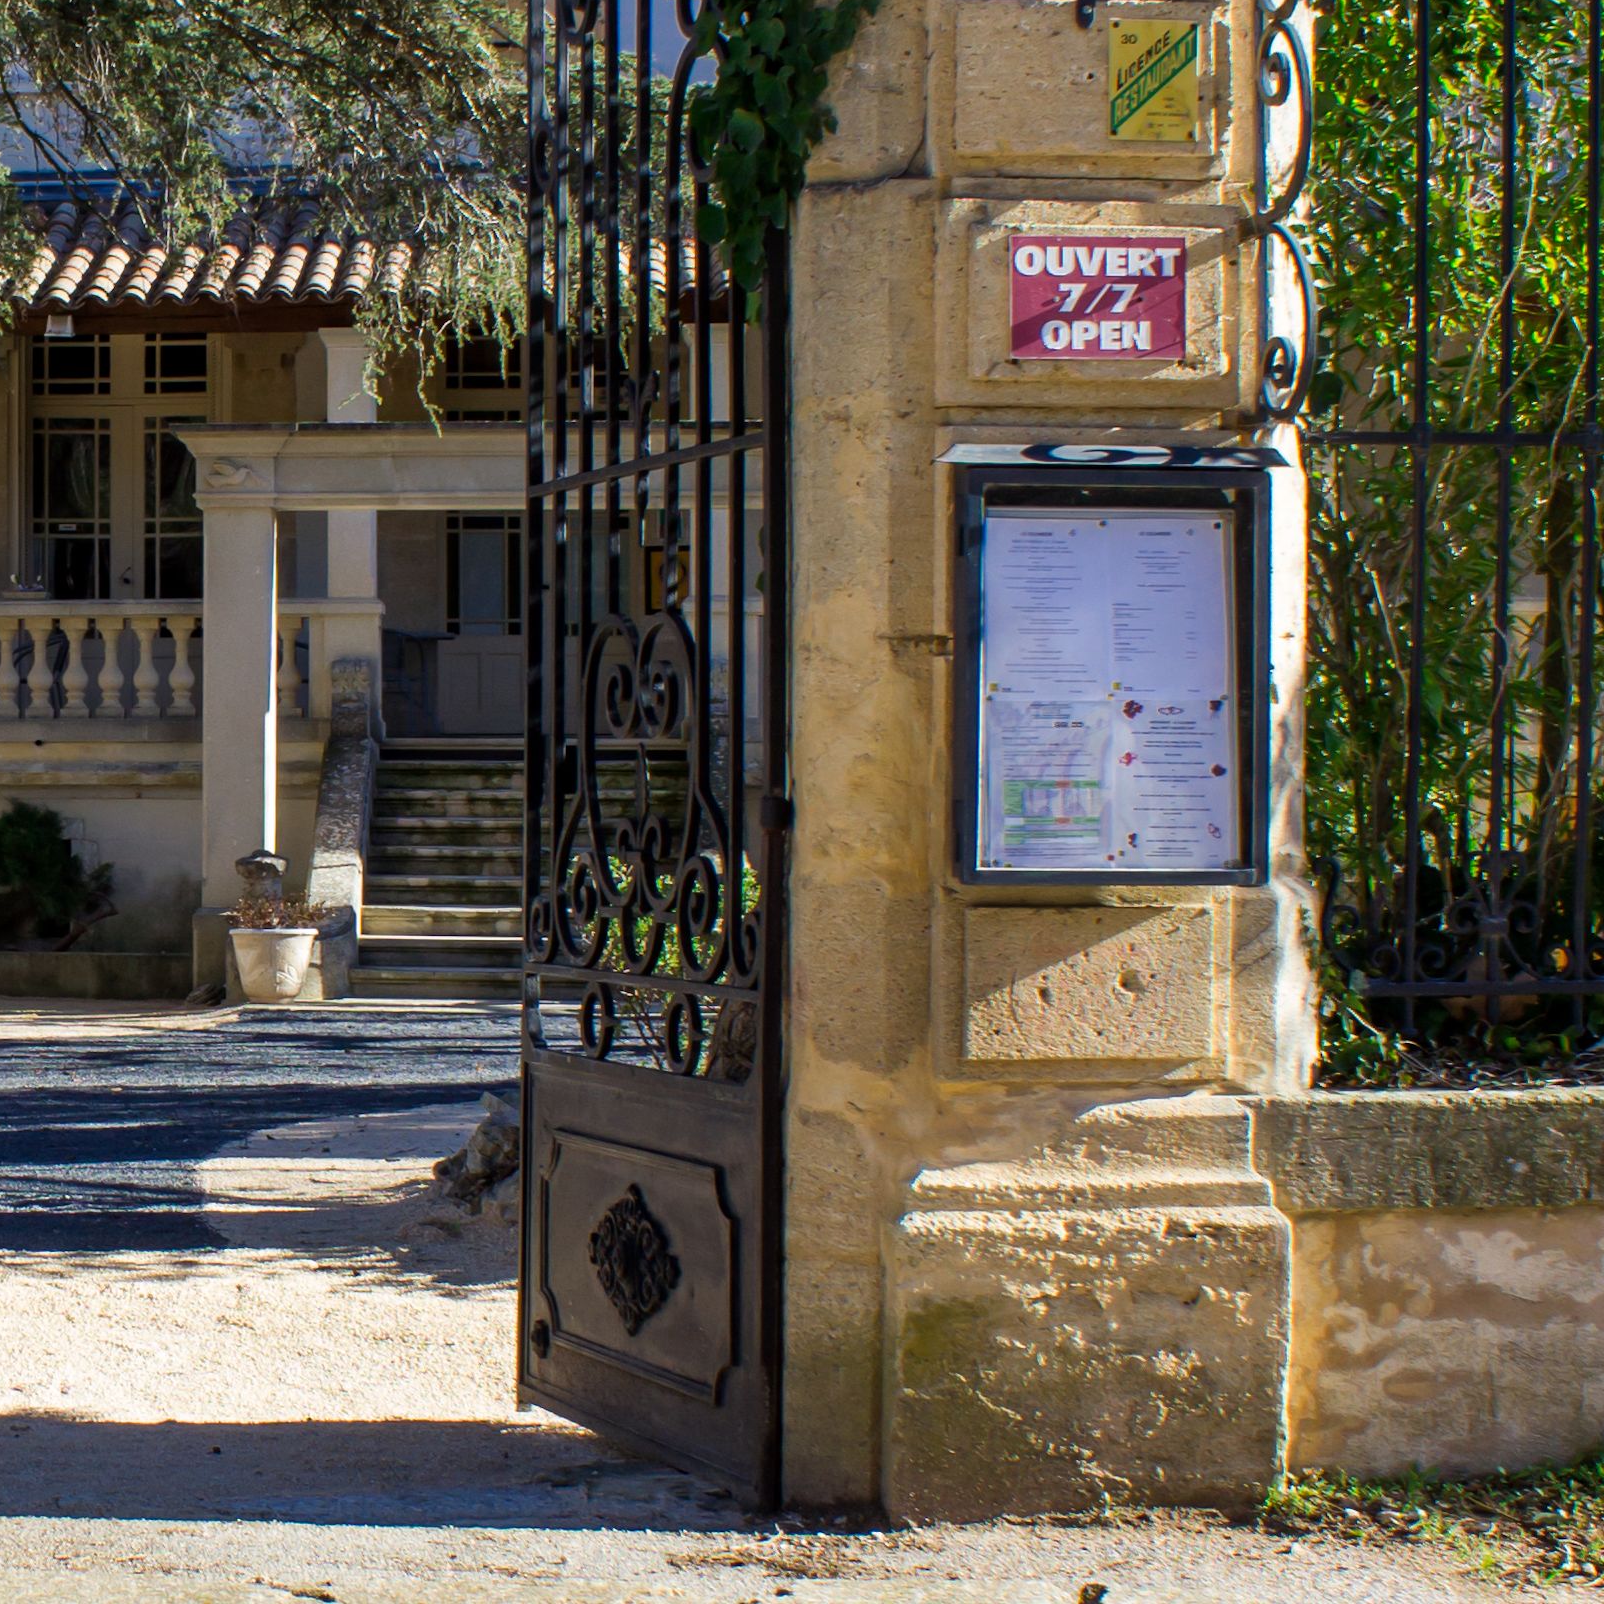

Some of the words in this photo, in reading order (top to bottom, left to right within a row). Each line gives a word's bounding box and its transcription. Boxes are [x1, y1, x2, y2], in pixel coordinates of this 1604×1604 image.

[1116, 30, 1170, 91] LICENCE
[1014, 245, 1181, 277] OUVERT
[1058, 283, 1139, 314] 7/7
[1040, 320, 1151, 350] OPEN
